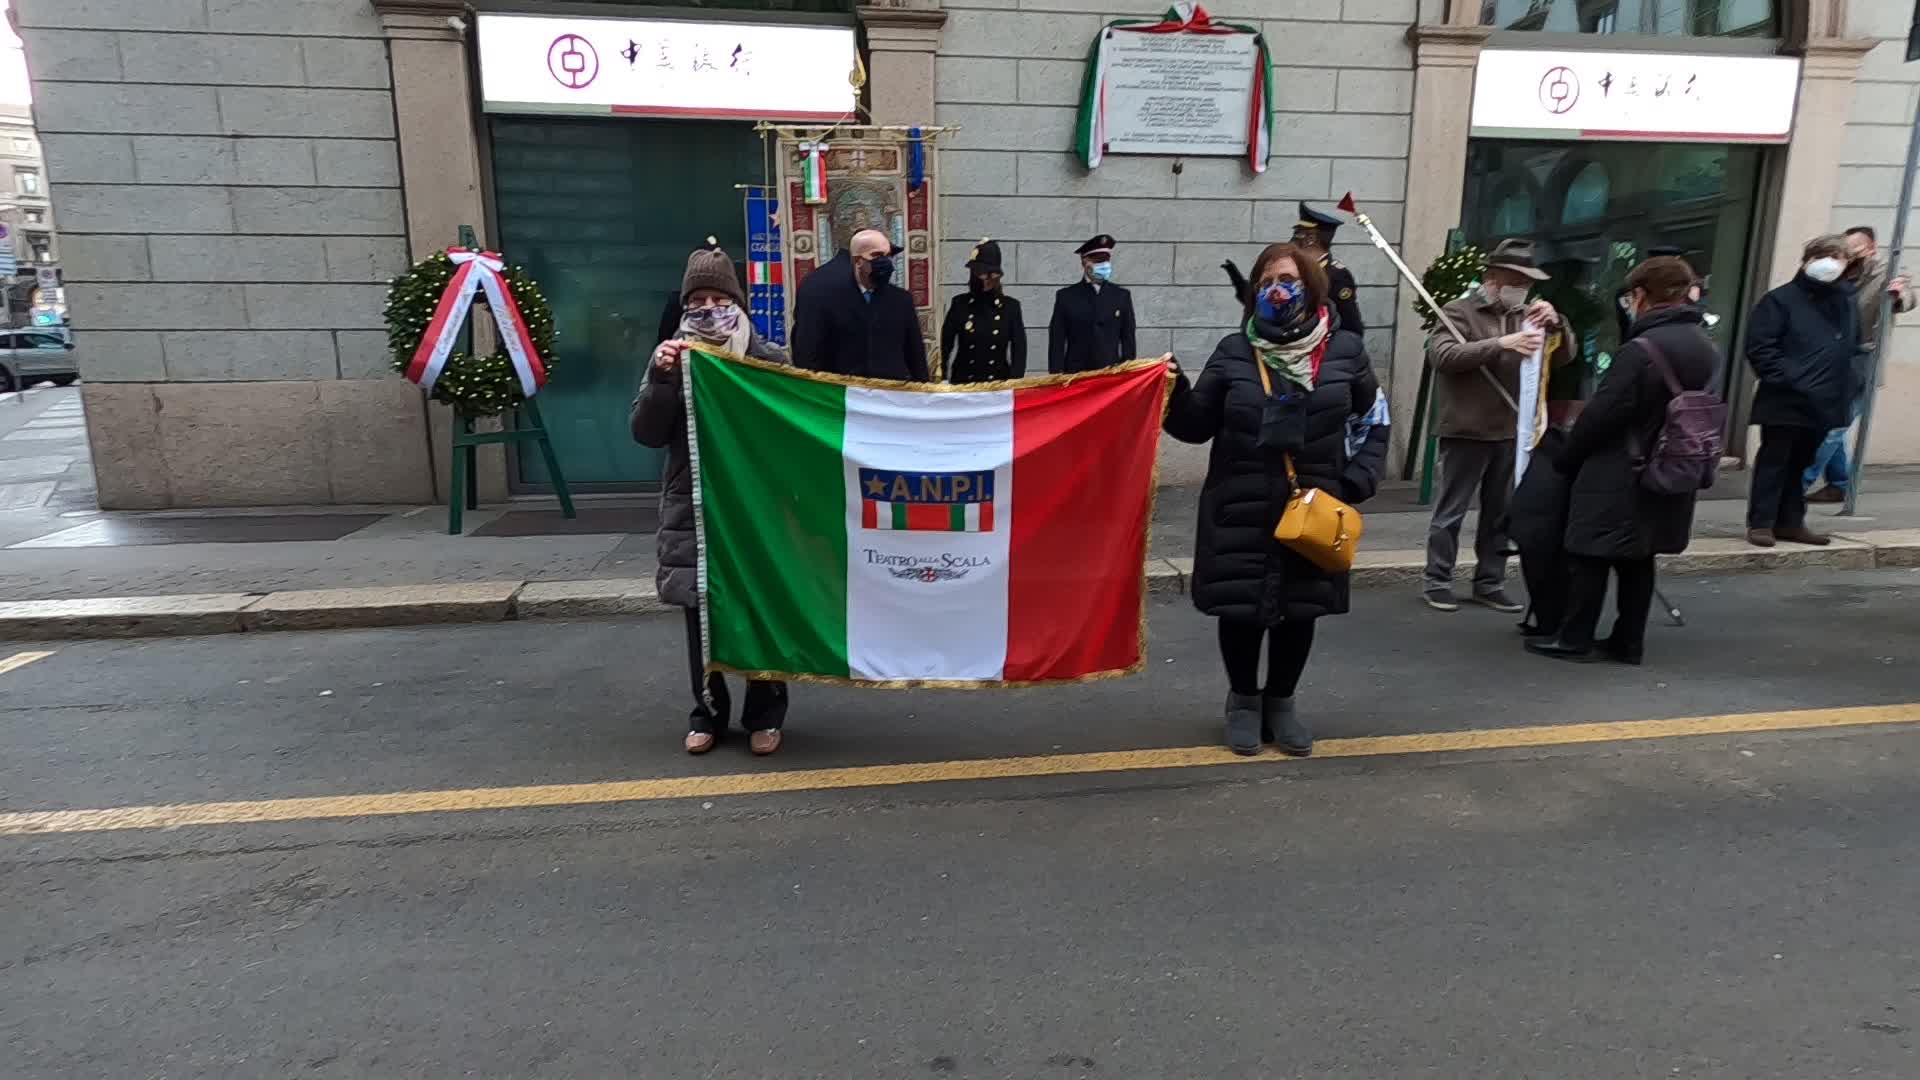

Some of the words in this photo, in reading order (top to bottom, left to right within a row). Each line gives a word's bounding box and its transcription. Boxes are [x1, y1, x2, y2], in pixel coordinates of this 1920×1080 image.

[890, 474, 992, 501] A.N.P.I.
[863, 548, 918, 567] TEATRO
[941, 552, 991, 568] SCALA
